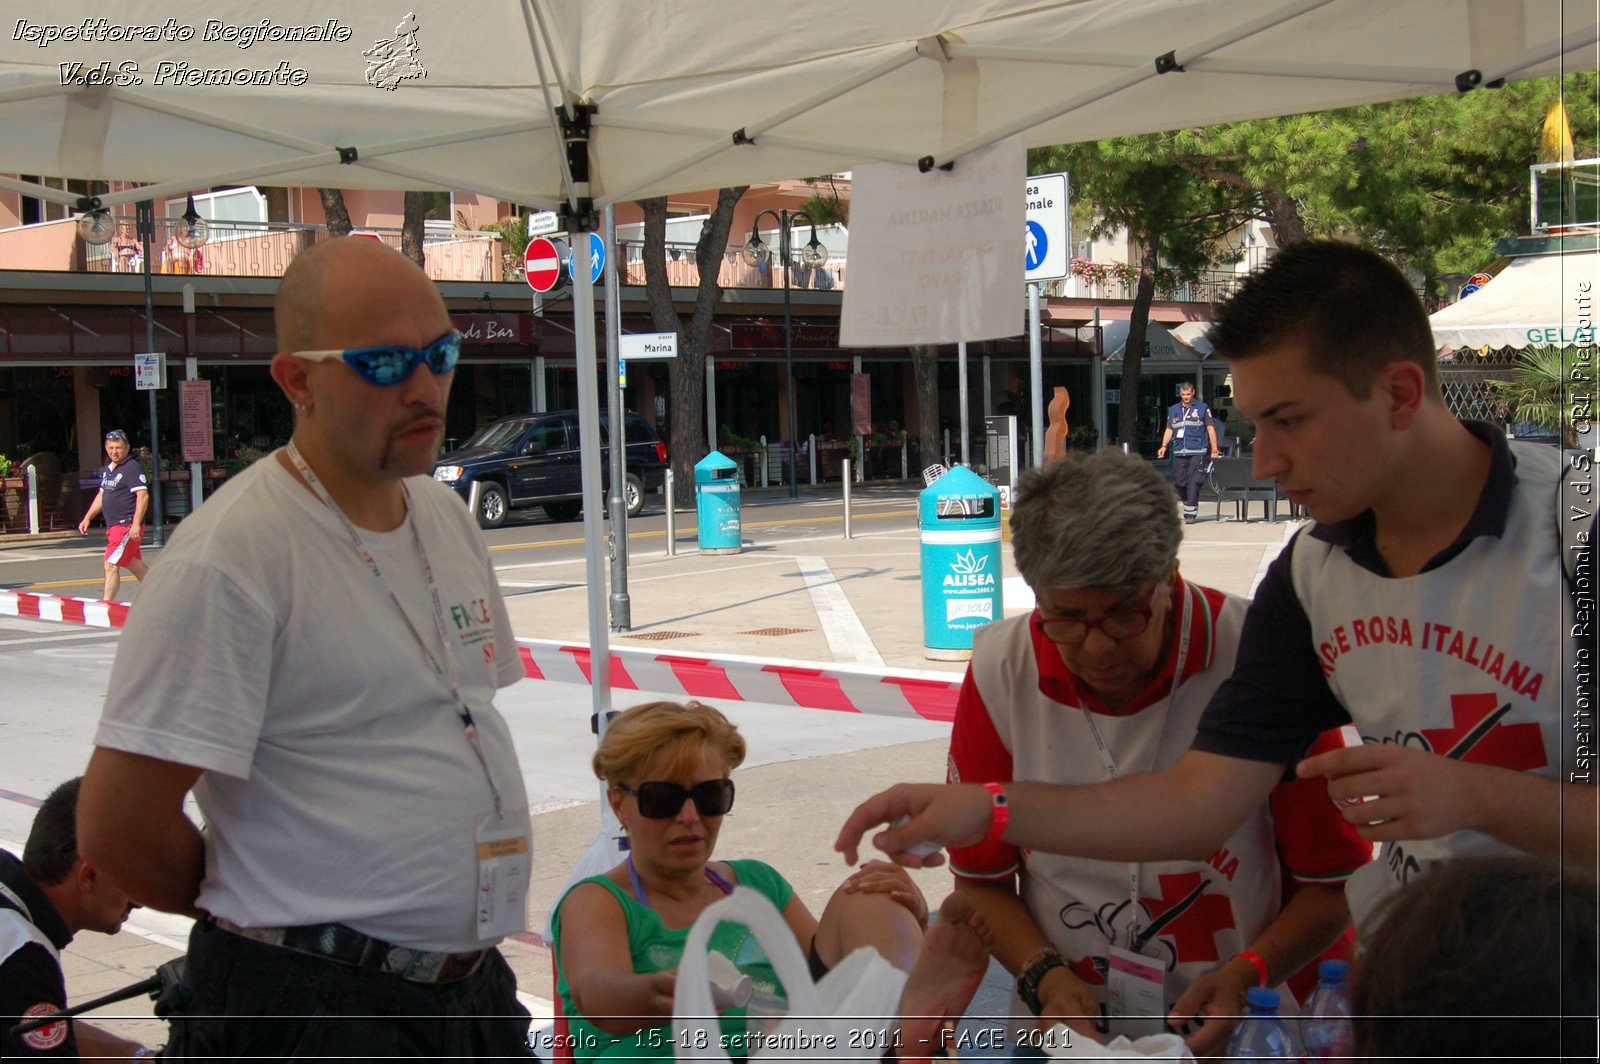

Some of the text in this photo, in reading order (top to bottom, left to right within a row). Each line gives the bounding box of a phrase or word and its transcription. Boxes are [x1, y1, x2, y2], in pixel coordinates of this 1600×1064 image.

[1026, 186, 1040, 195] ea
[486, 320, 516, 340] Bar
[644, 344, 672, 353] Marina
[942, 573, 996, 586] ALISEA
[1421, 622, 1544, 703] ITALIANA
